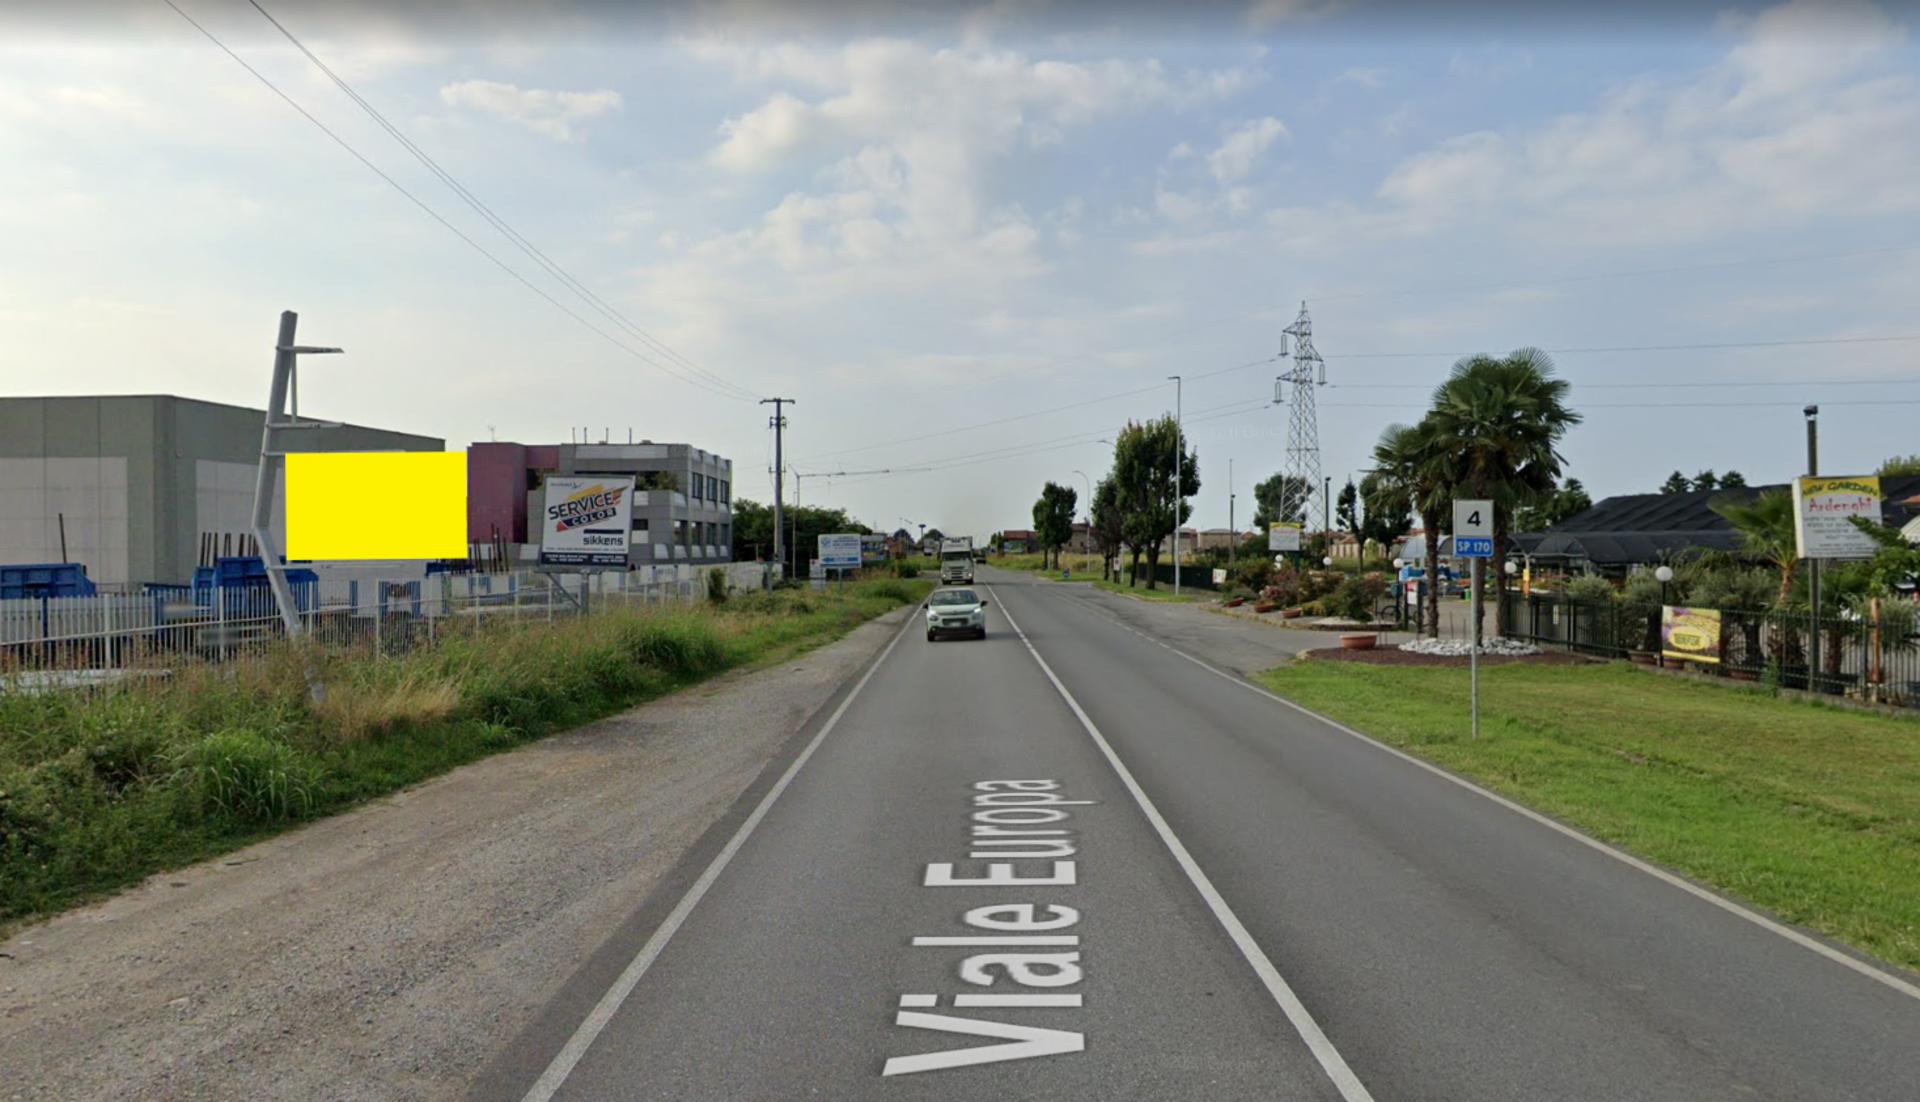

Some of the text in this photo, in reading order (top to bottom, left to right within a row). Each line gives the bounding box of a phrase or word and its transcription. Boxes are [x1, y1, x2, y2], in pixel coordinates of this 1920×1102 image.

[548, 492, 613, 520] SERVICE
[572, 510, 614, 525] COLOR
[1467, 510, 1481, 527] 4
[583, 534, 624, 546] sikkens
[1457, 541, 1490, 552] SP 170
